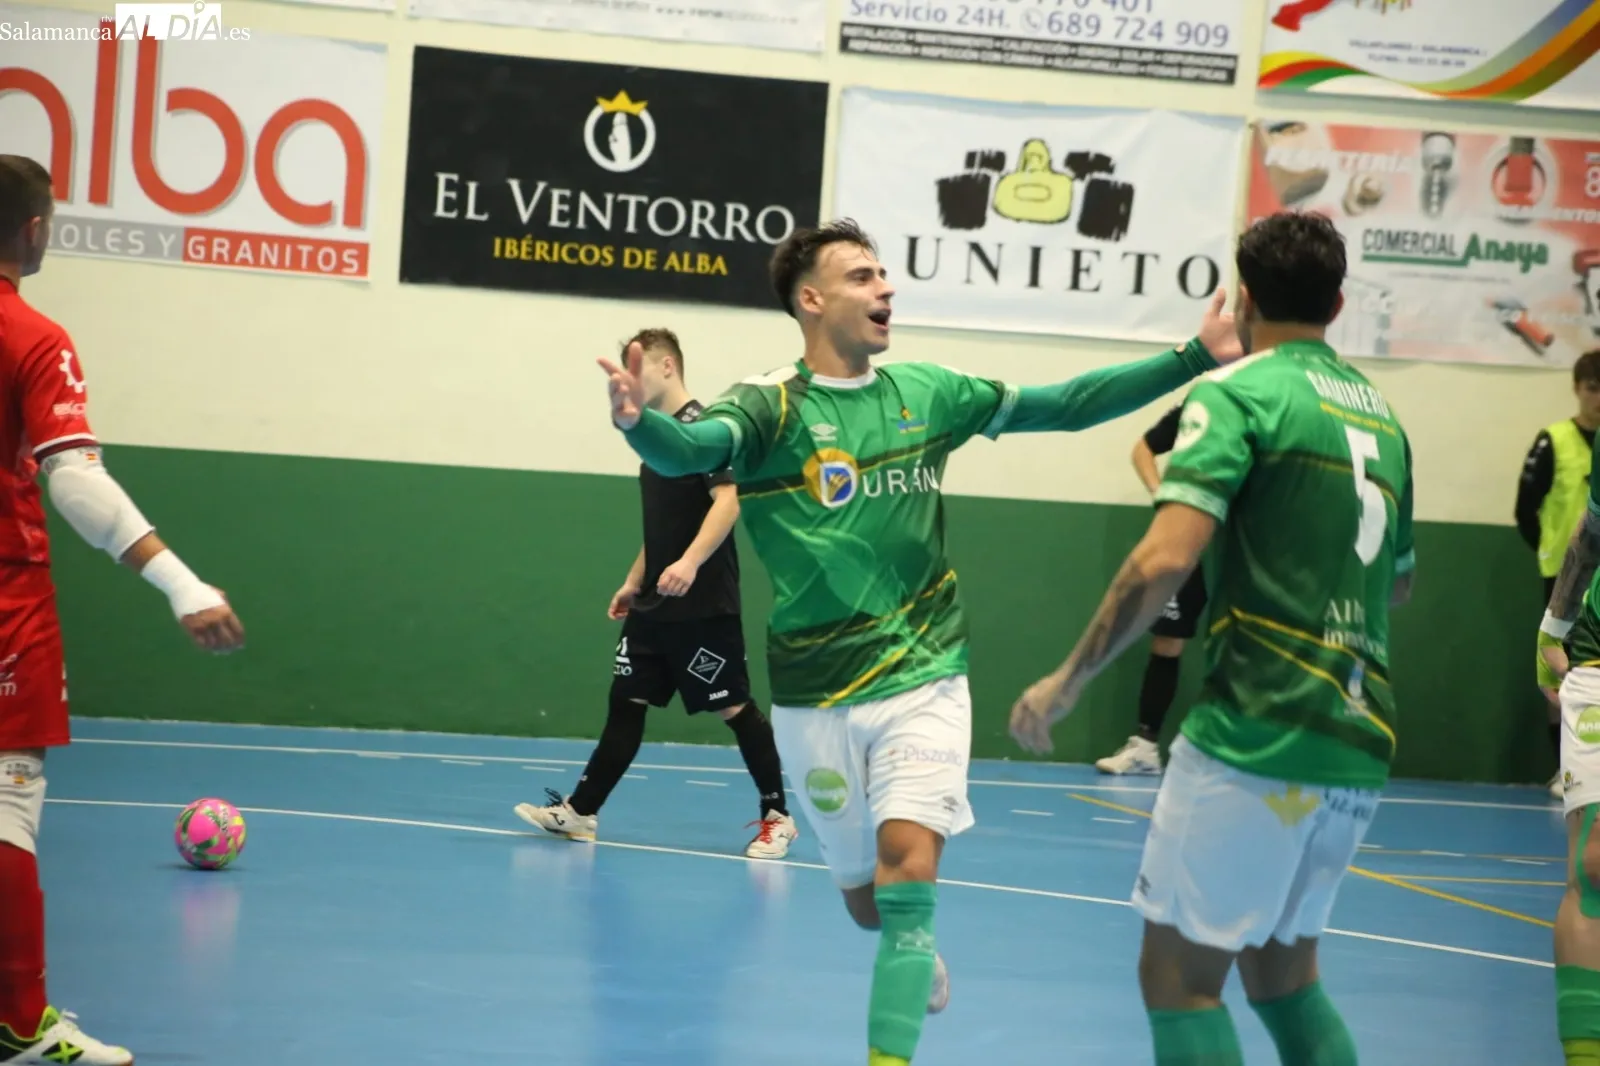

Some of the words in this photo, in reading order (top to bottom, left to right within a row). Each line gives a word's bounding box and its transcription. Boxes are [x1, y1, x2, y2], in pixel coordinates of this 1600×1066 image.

[851, 0, 948, 22] Servicio
[1047, 11, 1101, 37] 689
[1113, 16, 1164, 41] 724
[1176, 21, 1229, 47] 909
[434, 172, 489, 221] EL
[507, 178, 796, 244] VENTORRO
[157, 233, 177, 258] Y
[187, 236, 361, 274] GRANITOS
[493, 234, 614, 266] IBÉRICOS
[623, 248, 657, 270] DE
[664, 253, 729, 275] ALBA
[906, 236, 1221, 301] UNIETO
[1361, 229, 1458, 257] COMERCIAL
[1464, 233, 1550, 274] Anaya
[1344, 424, 1388, 567] 5
